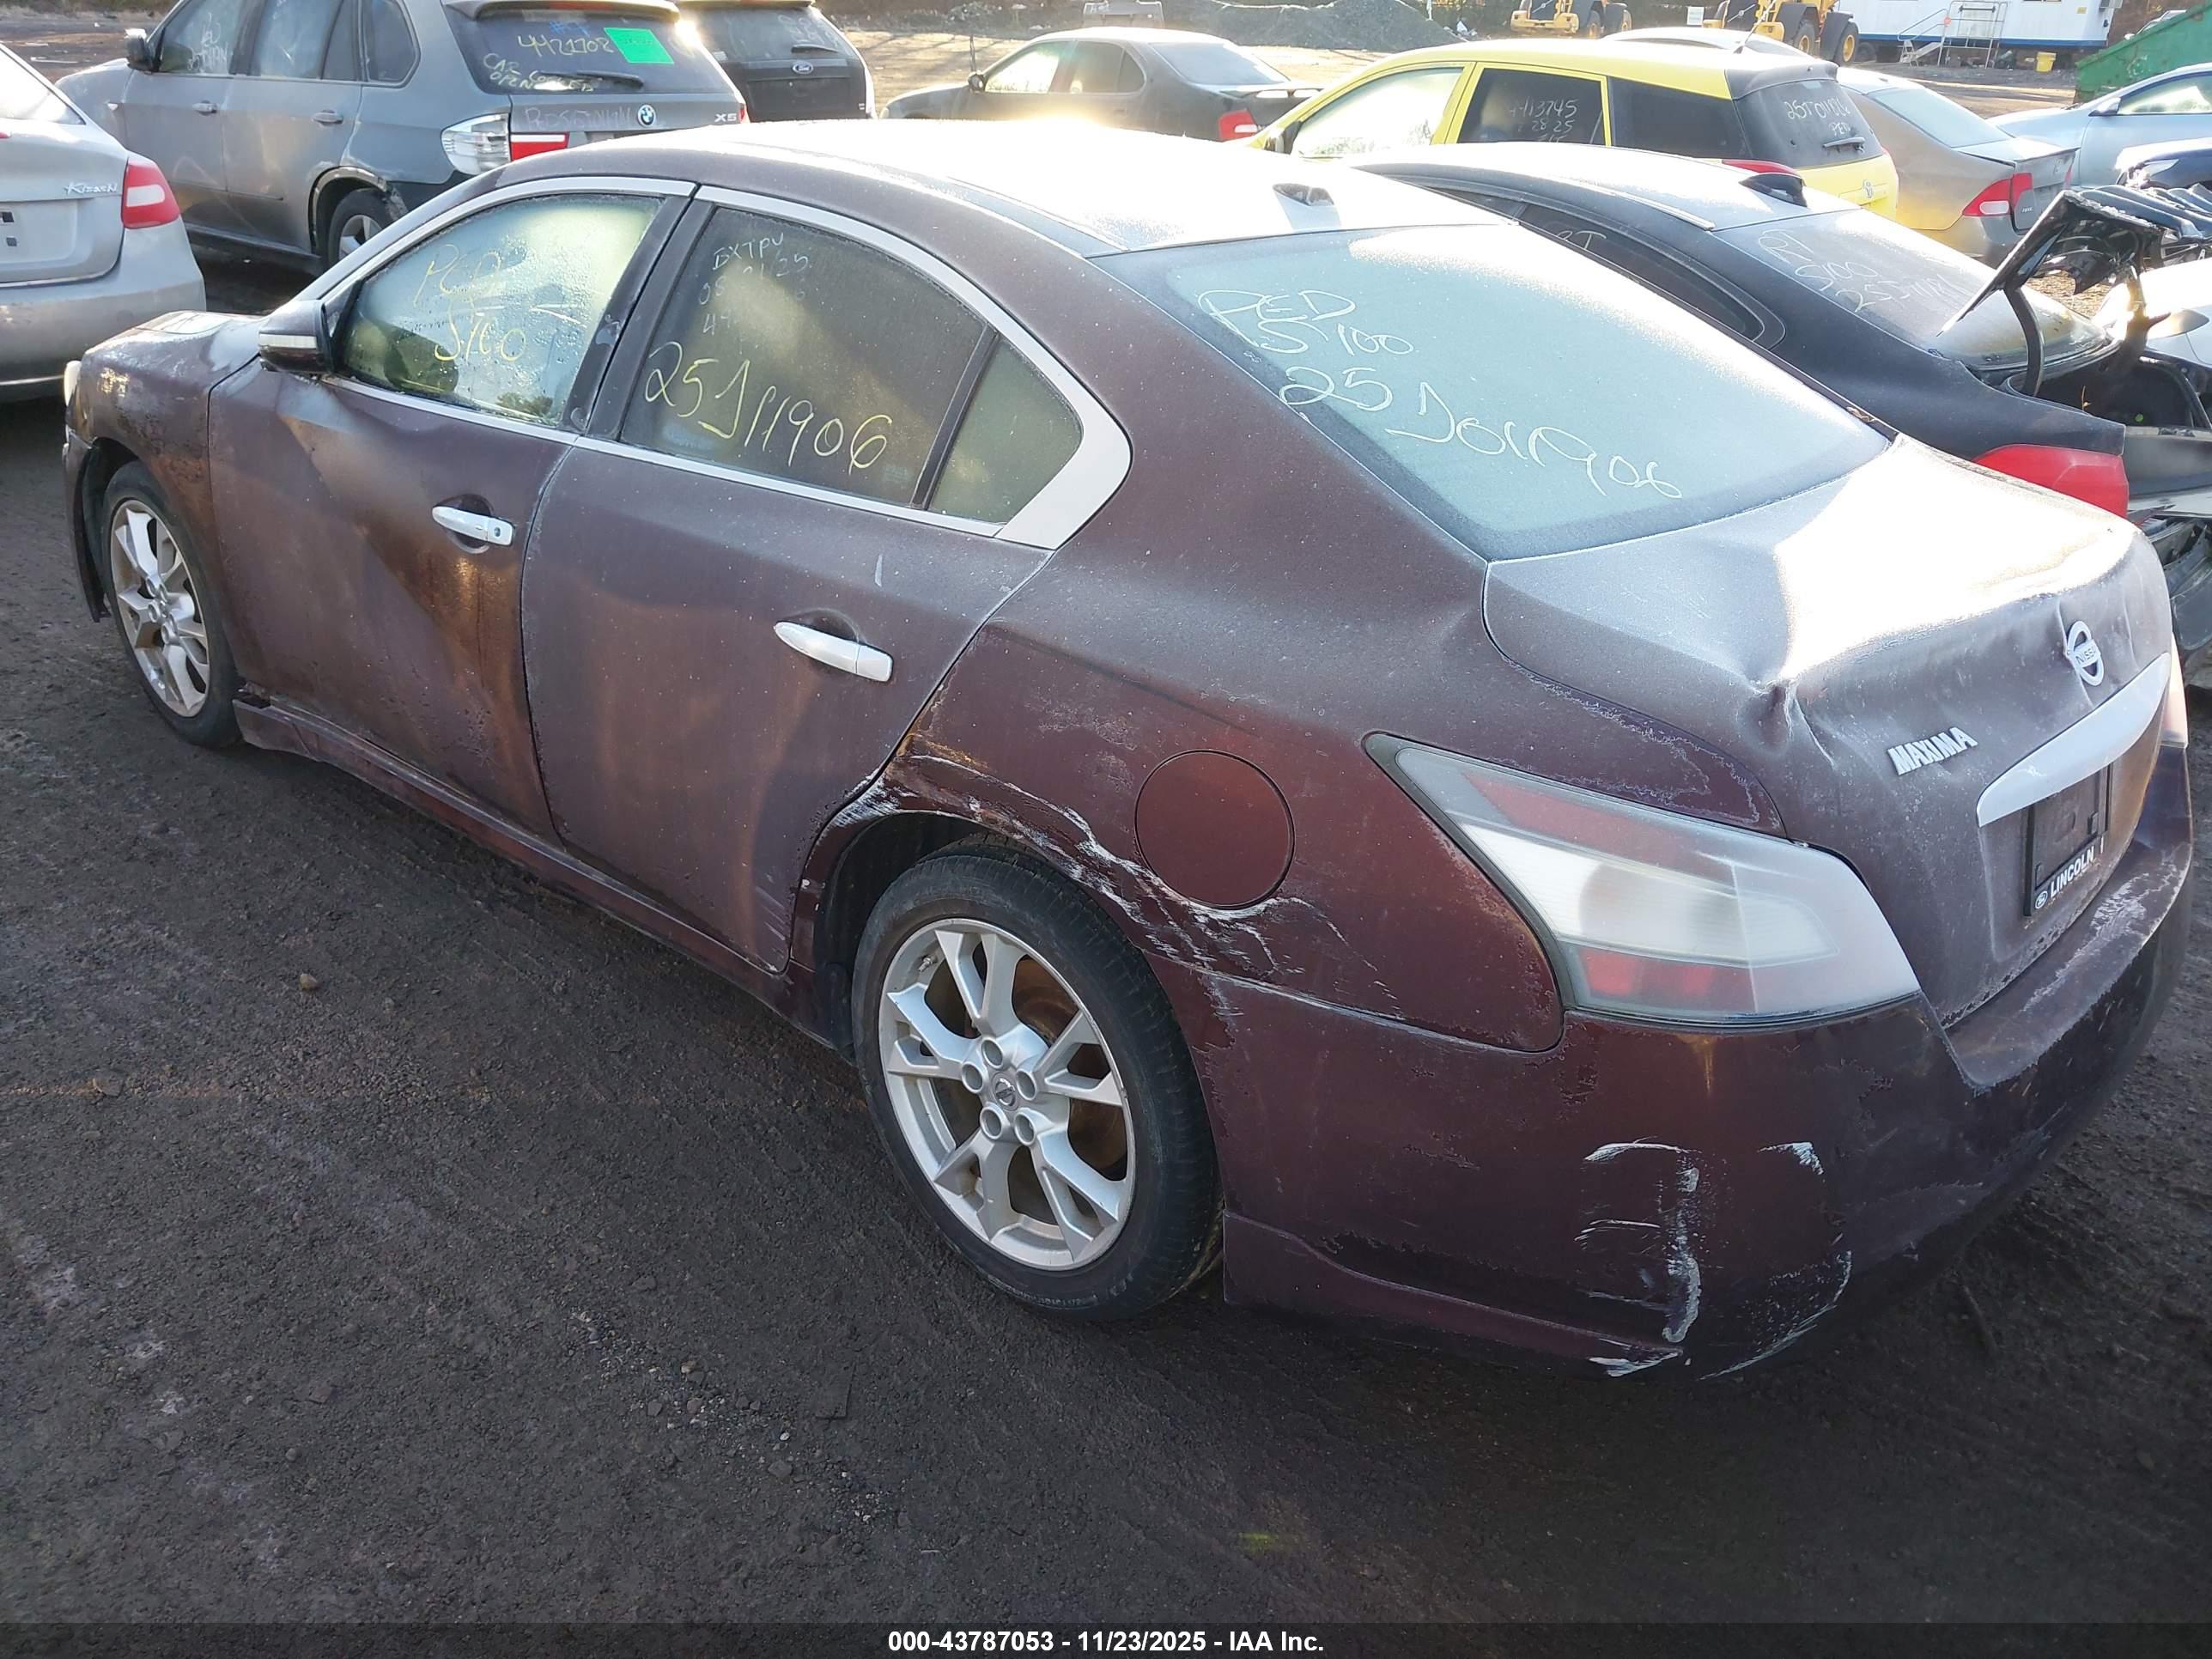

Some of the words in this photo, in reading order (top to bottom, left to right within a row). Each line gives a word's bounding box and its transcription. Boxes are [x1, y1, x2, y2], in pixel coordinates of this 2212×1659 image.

[714, 113, 737, 123] X5
[1887, 726, 1978, 775] MAXIMA
[2050, 845, 2095, 899] LINCOLN
